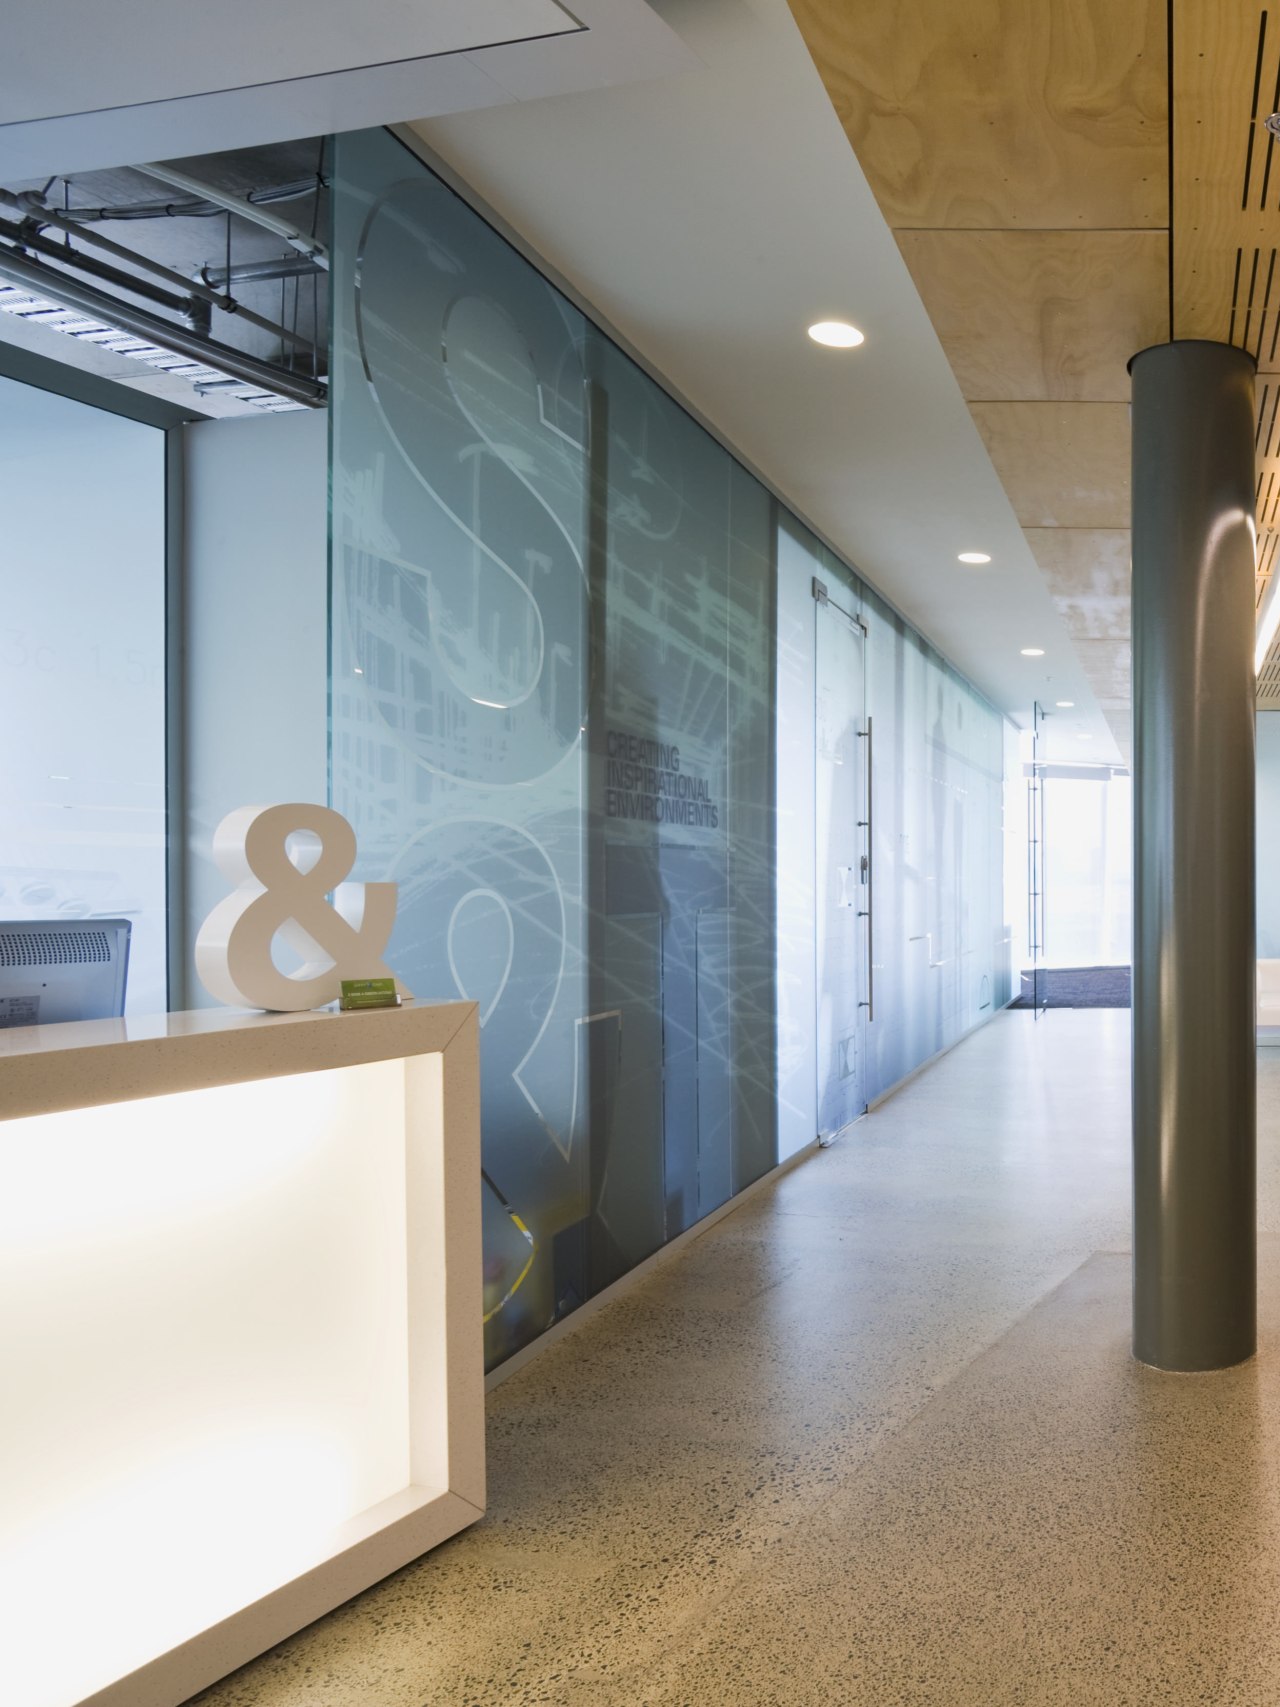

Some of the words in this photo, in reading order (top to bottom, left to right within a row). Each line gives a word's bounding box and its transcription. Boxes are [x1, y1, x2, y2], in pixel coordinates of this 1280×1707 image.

[607, 730, 680, 772] CREATING
[606, 759, 712, 803] INSPIRATIONAL
[606, 789, 719, 829] ENVIRONMENTS
[226, 802, 415, 1012] &
